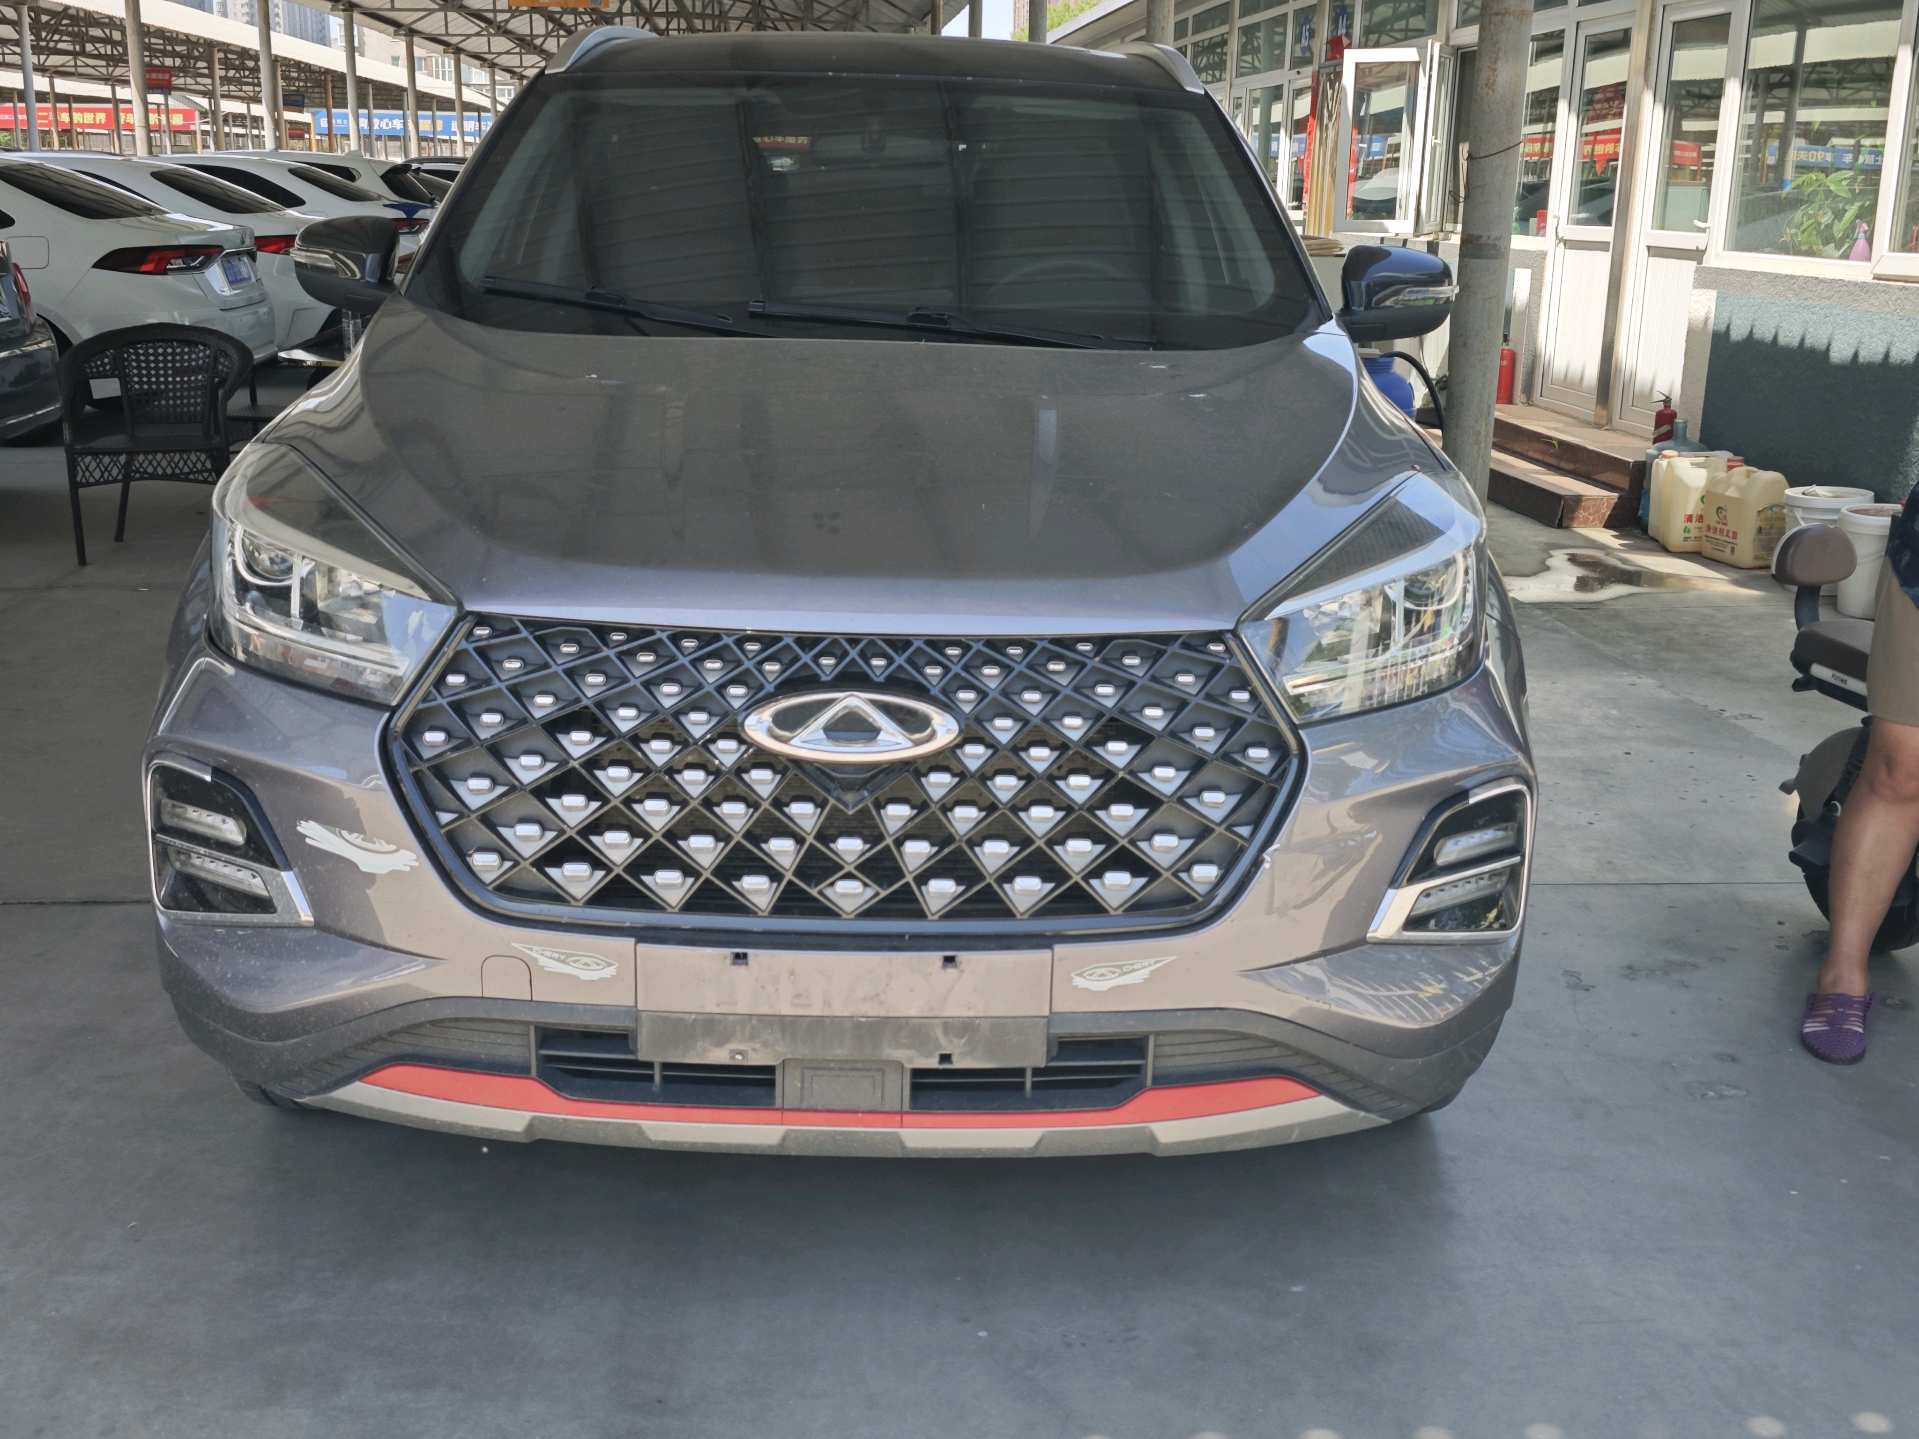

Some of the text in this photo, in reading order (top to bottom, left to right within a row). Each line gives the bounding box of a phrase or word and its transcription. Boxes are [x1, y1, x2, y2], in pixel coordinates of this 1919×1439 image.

[38, 112, 106, 125] 二车的世界
